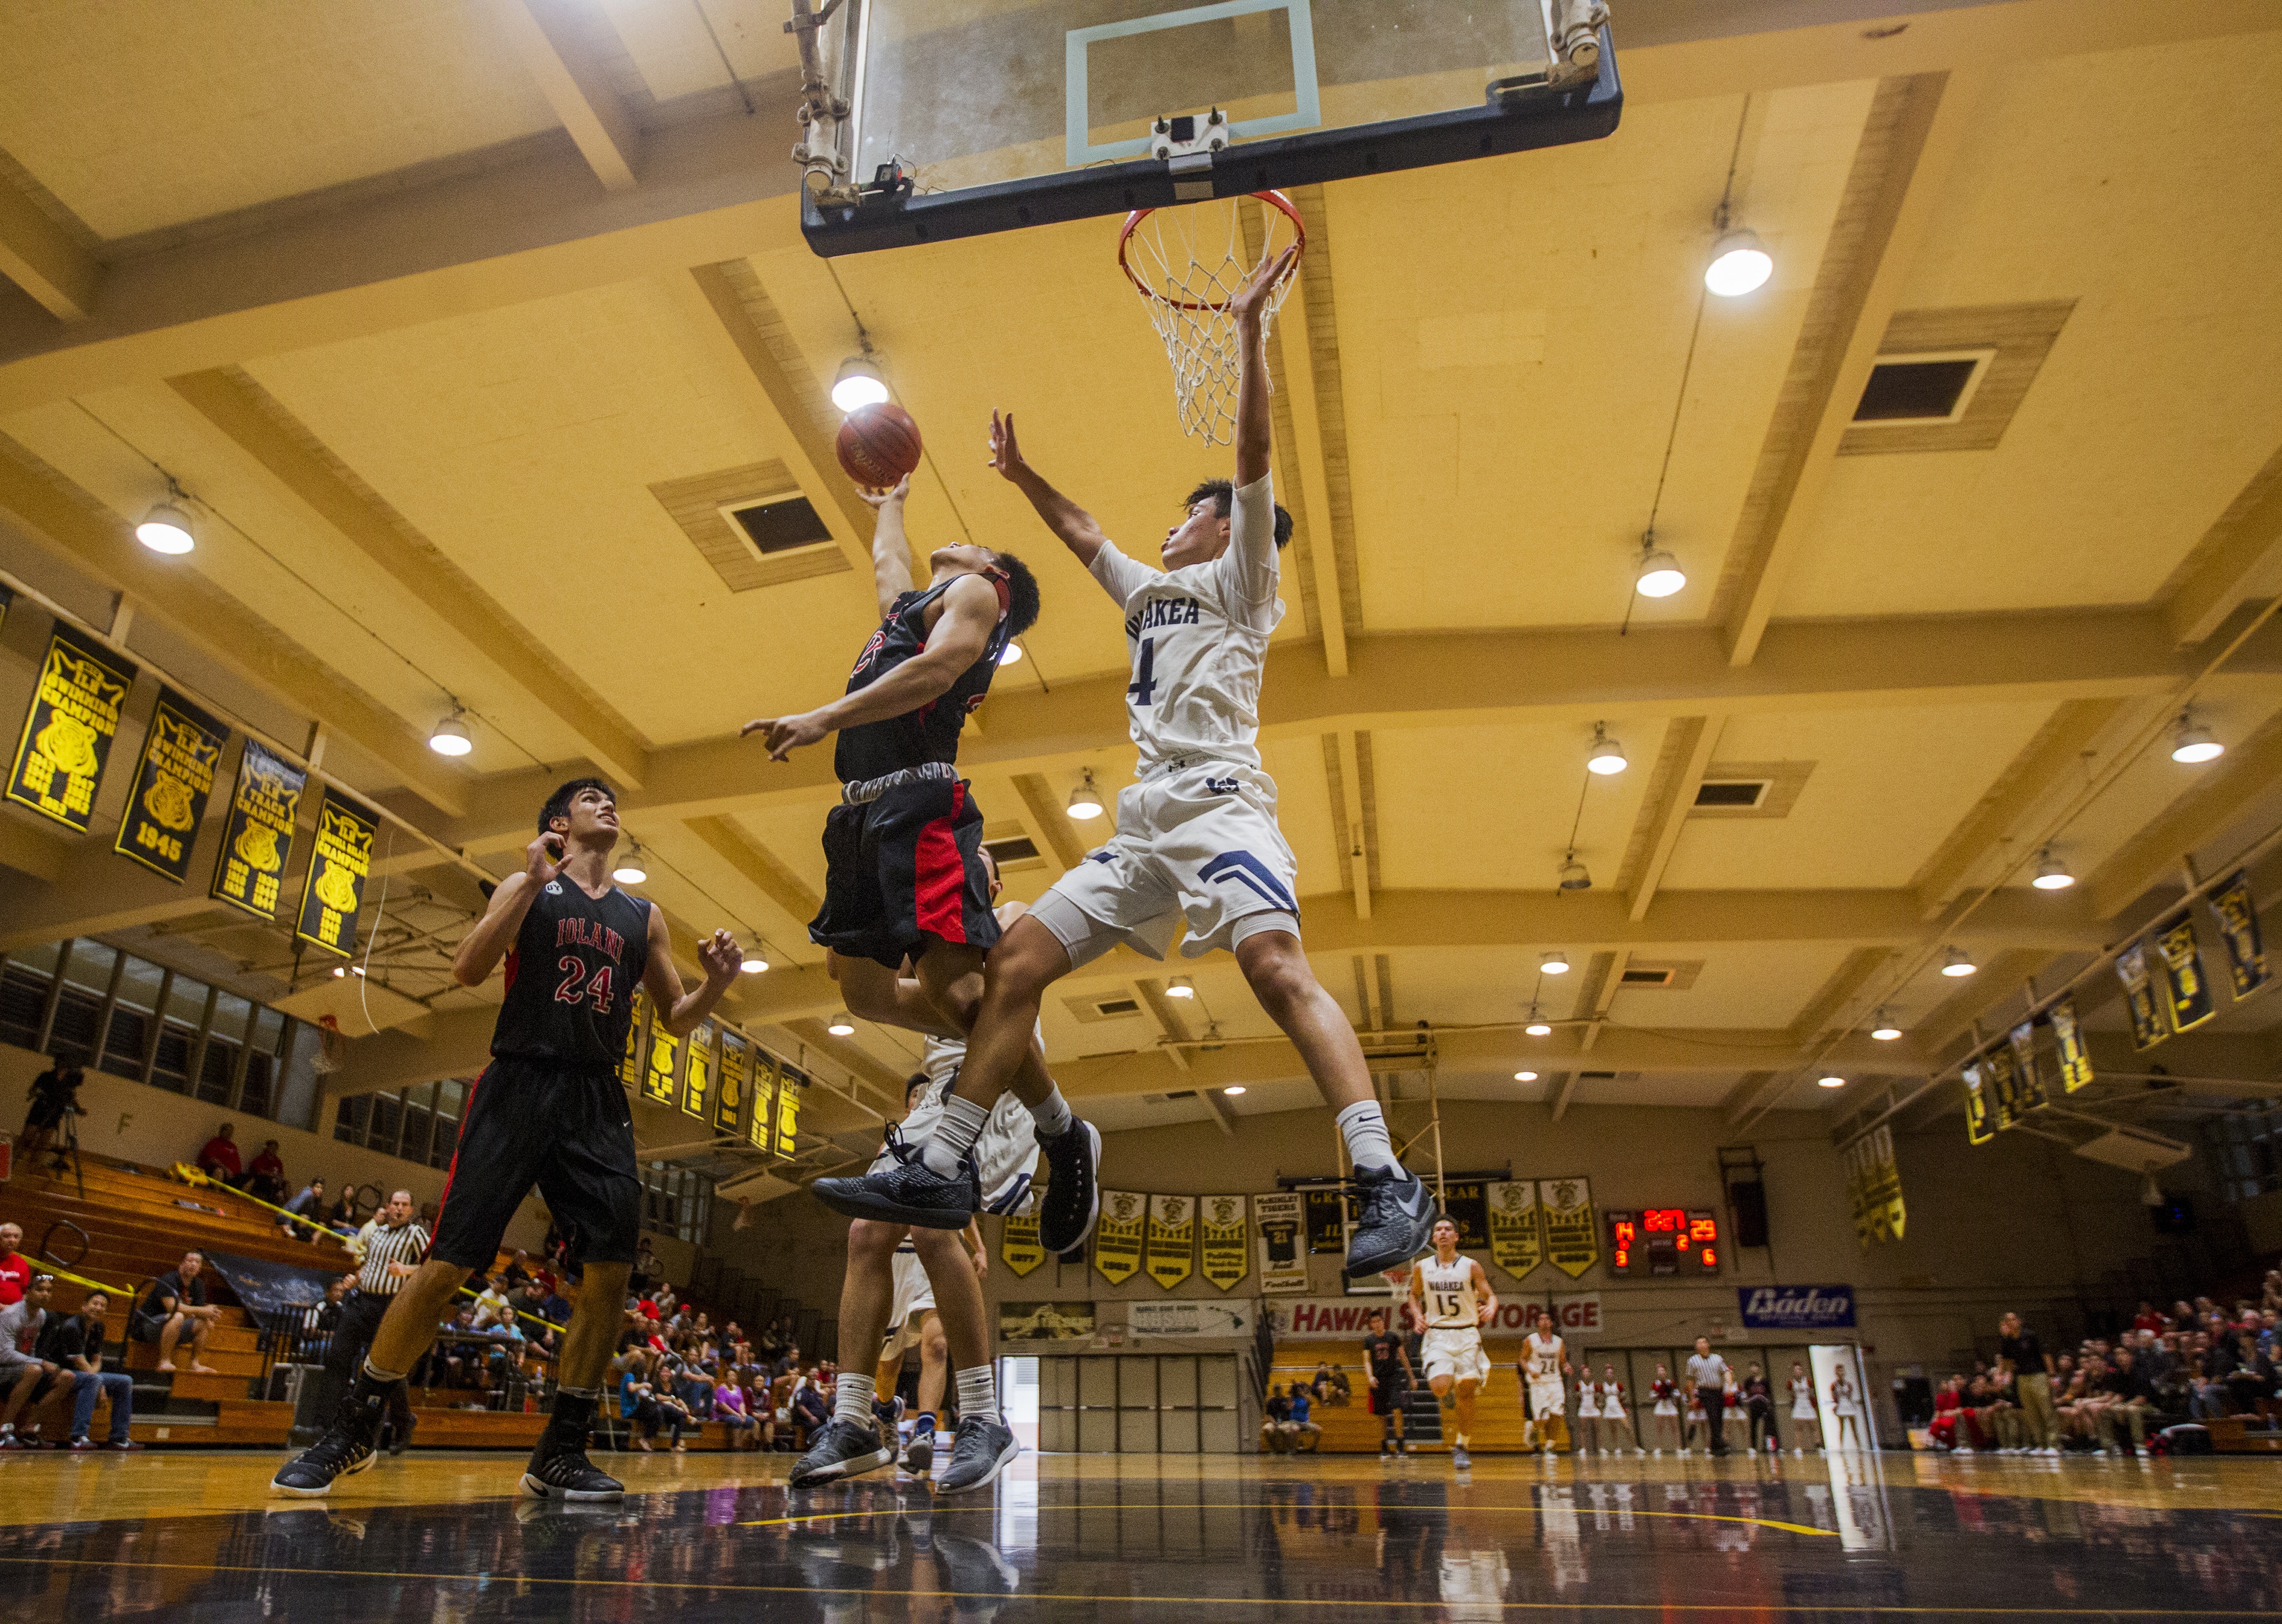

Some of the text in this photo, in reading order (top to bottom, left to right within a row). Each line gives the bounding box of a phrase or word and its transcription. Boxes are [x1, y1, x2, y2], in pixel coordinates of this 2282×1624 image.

[1127, 637, 1158, 705] 4
[46, 671, 118, 724] SWIMMING
[40, 685, 115, 736] CHAMPION
[153, 735, 213, 781] SWIMMING
[148, 748, 210, 794] CHAMPION
[250, 788, 286, 818] TRACK
[237, 797, 294, 835] CHAMPION
[136, 820, 183, 862] 1945
[317, 840, 369, 877] CHAMPION
[555, 918, 625, 965] IOLANI
[554, 955, 614, 1015] 24
[1262, 1203, 1296, 1212] TIGERS
[1492, 1211, 1535, 1226] STATE
[1546, 1208, 1590, 1225] STATE
[1102, 1218, 1141, 1236] STATE
[1151, 1223, 1191, 1239] STATE
[1203, 1224, 1244, 1238] STATE
[1644, 1209, 1685, 1231] 2:27
[1690, 1220, 1716, 1241] 29
[1273, 1231, 1288, 1244] 21
[1615, 1222, 1635, 1241] 14
[1677, 1234, 1689, 1251] 2
[1615, 1250, 1628, 1267] 3
[1702, 1248, 1716, 1265] 6
[1436, 1294, 1460, 1316] 15
[1476, 1302, 1599, 1329] TORGE
[1541, 1361, 1556, 1374] 24
